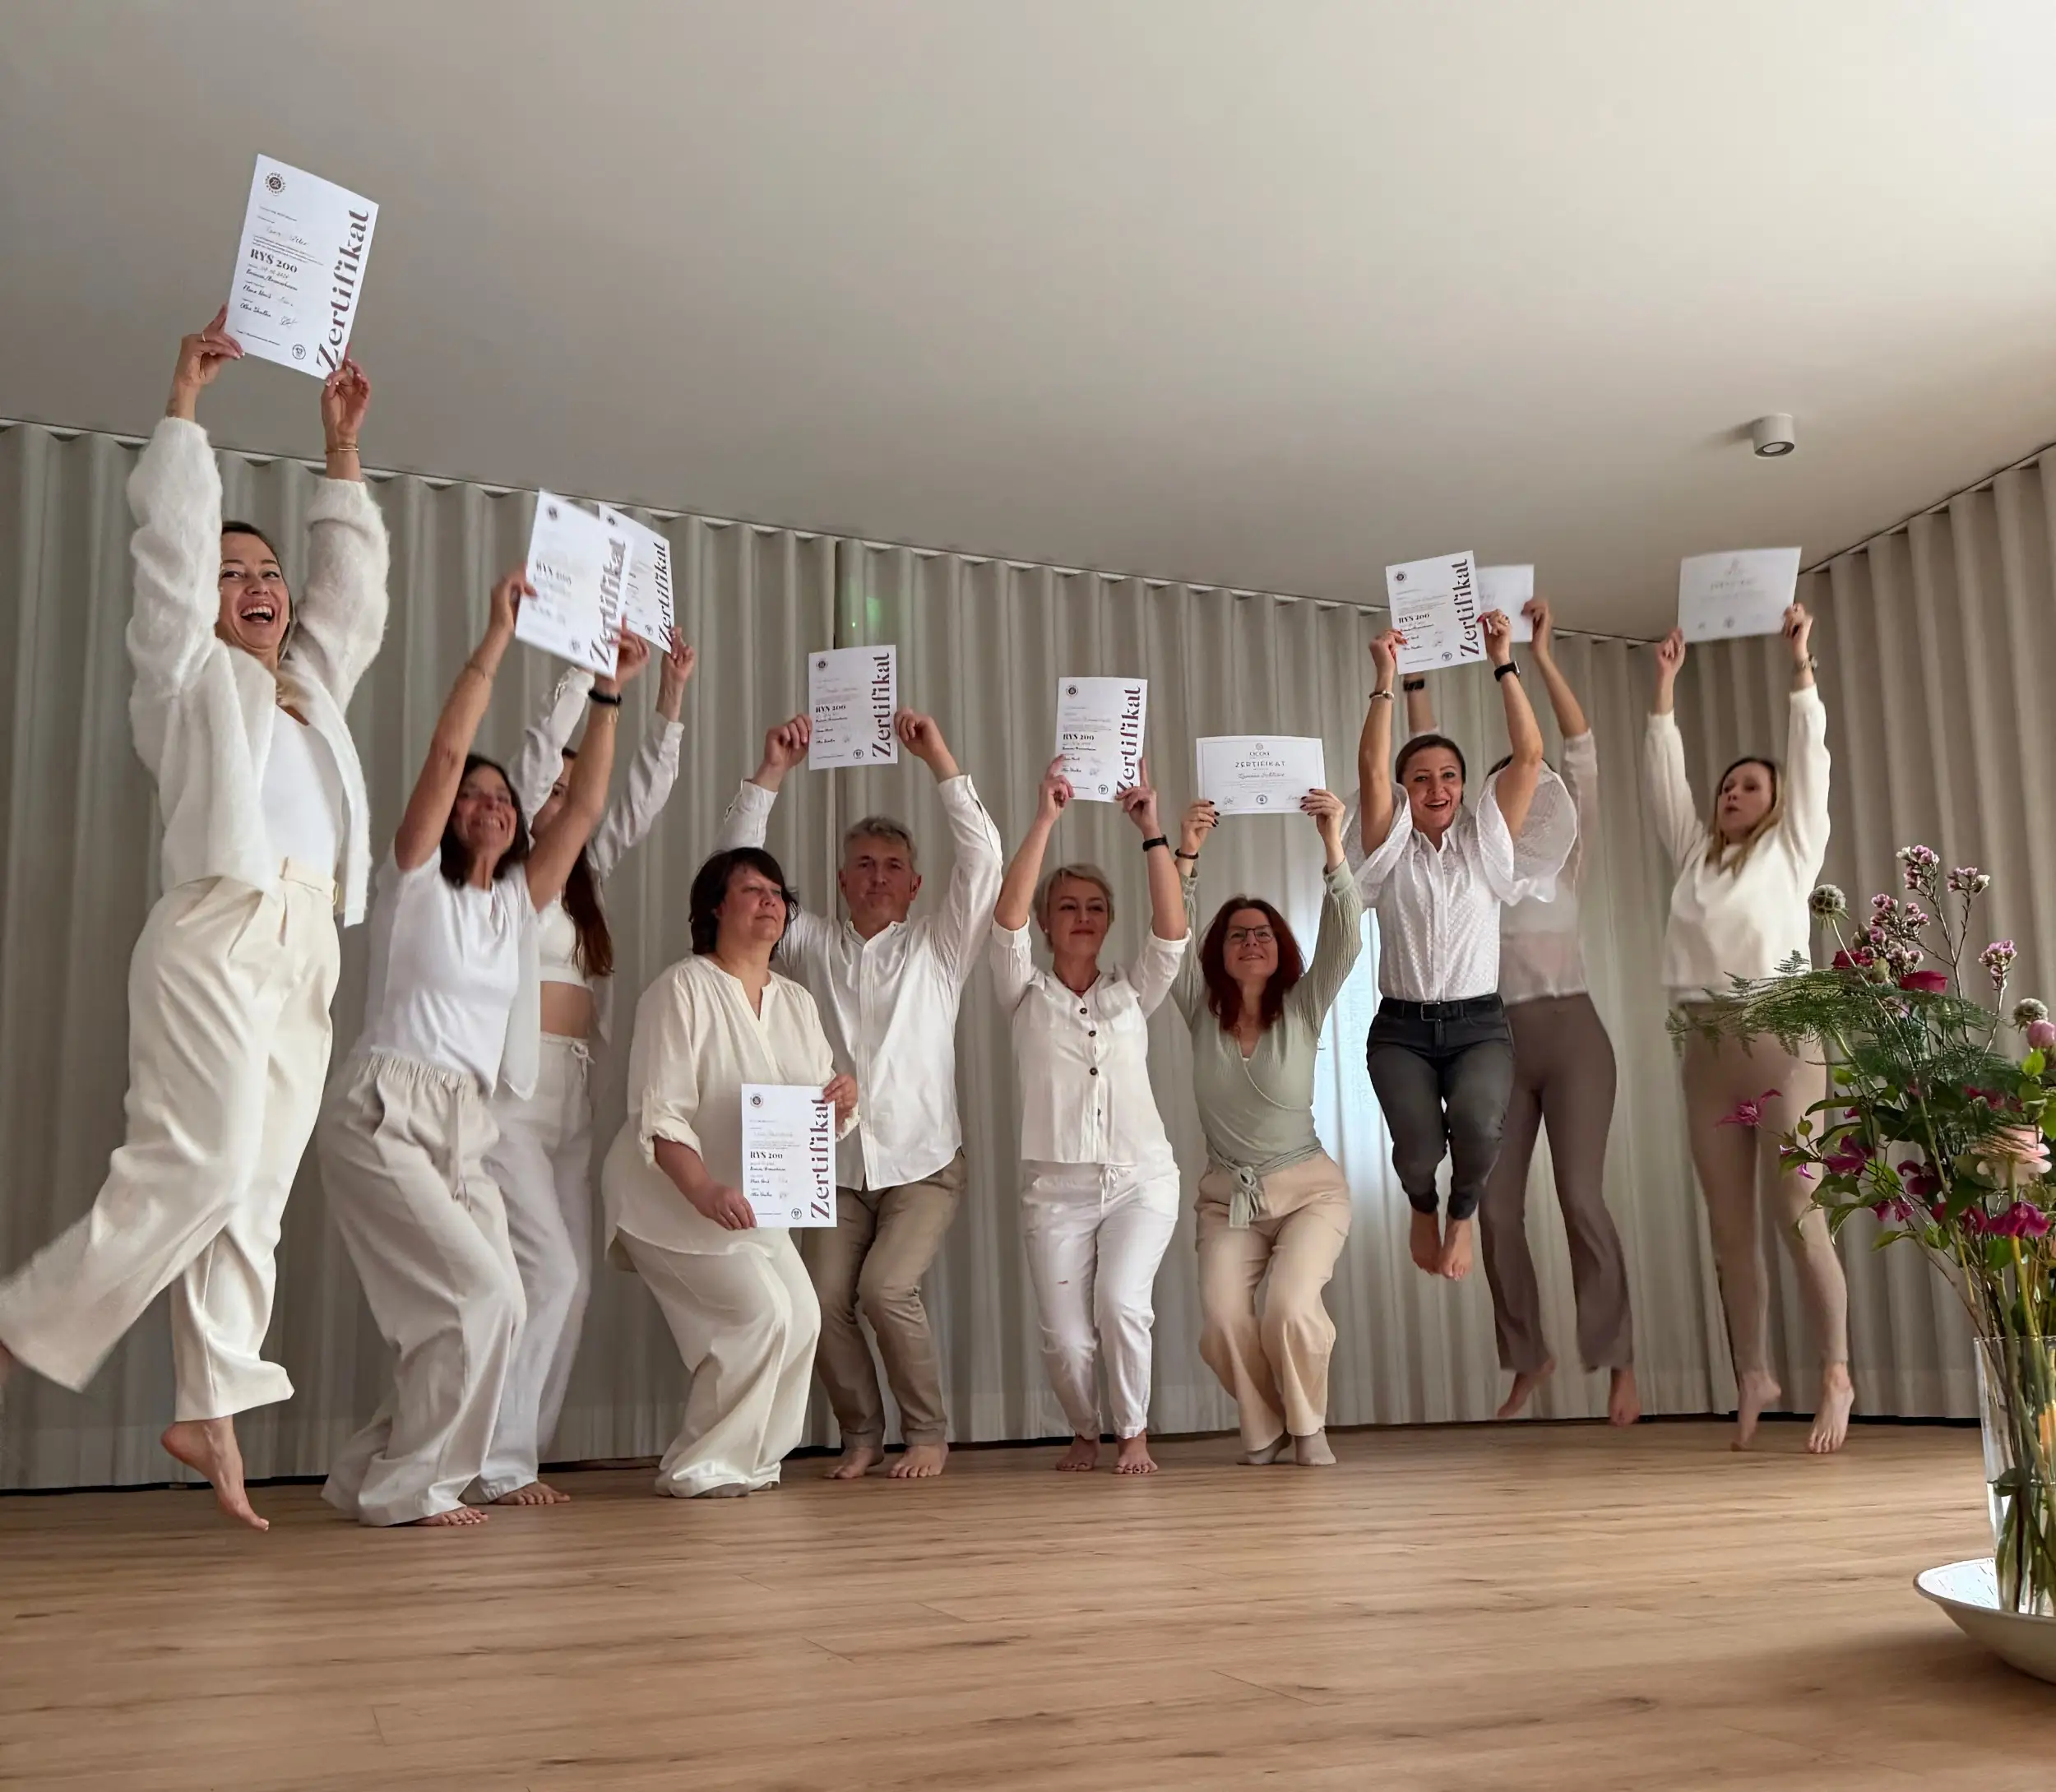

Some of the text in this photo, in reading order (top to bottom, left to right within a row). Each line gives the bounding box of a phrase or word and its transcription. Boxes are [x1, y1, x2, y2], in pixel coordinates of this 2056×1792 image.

[249, 248, 274, 265] RYS
[276, 257, 298, 274] 200
[316, 209, 369, 372] Zertifikat
[652, 541, 673, 647] Zertifikat
[1451, 558, 1479, 657] Zertifikat
[872, 652, 891, 757] Zertifikat
[809, 1099, 830, 1220] Zertifikat
